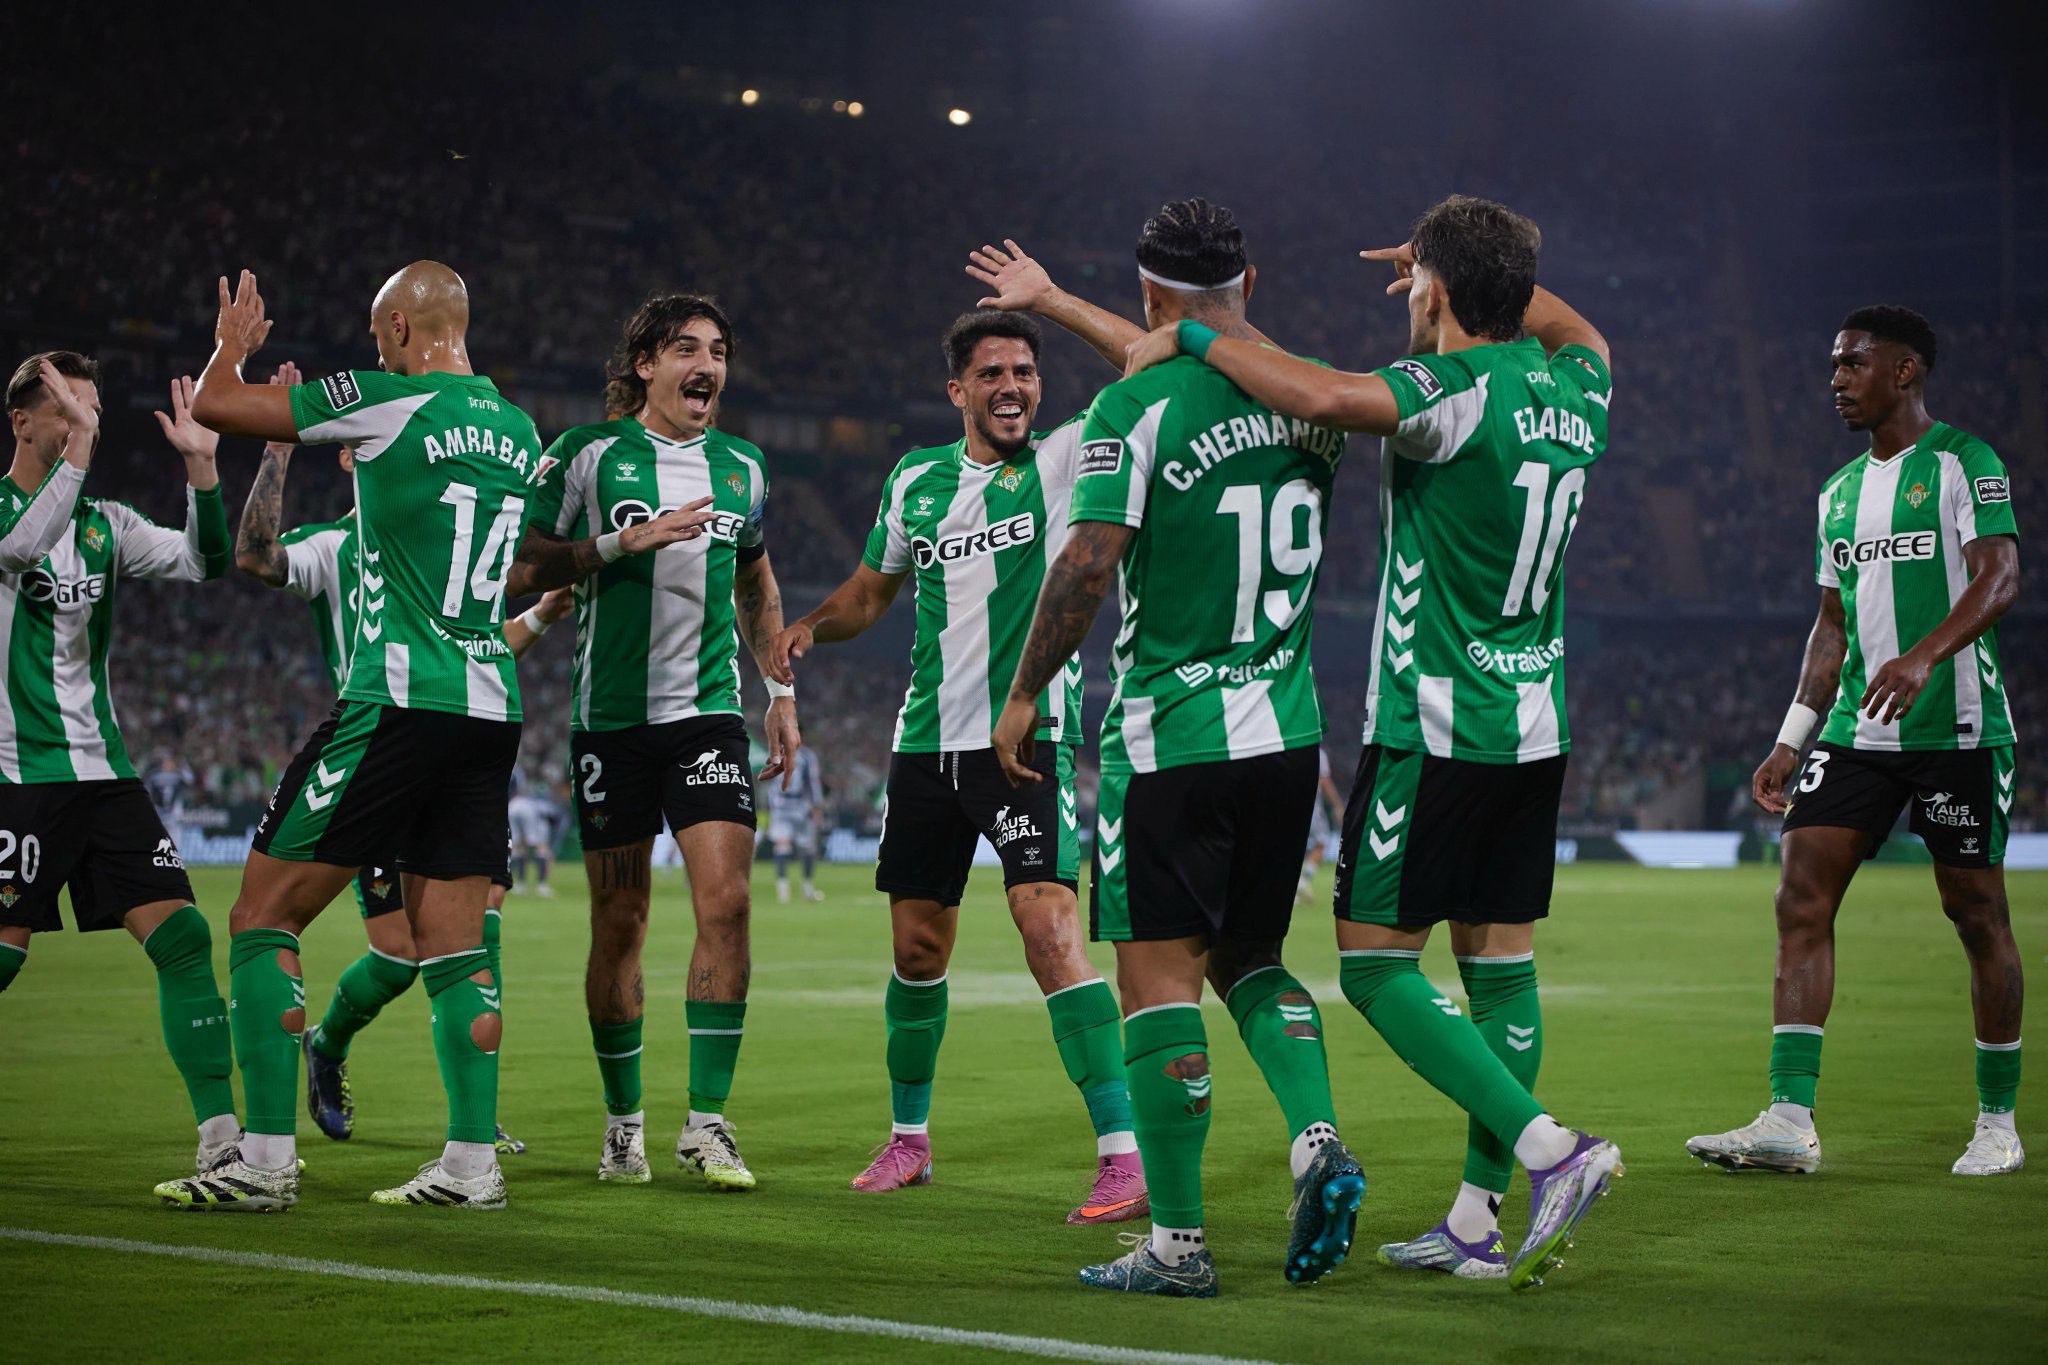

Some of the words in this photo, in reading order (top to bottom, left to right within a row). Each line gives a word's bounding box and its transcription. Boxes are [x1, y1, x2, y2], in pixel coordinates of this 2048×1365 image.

[336, 371, 353, 402] EVEL
[1080, 446, 1117, 461] EVEL
[1979, 481, 2005, 491] REV
[938, 515, 1031, 561] GREE
[1501, 461, 1587, 617] 10
[1854, 534, 1933, 563] GREE
[439, 482, 525, 624] 14
[1215, 478, 1323, 644] 19
[57, 577, 102, 604] GRE
[580, 753, 607, 804] 2
[686, 773, 750, 788] GLOBAL
[706, 763, 740, 775] AUS
[1001, 815, 1030, 833] AUS
[1937, 804, 1970, 816] AUS
[0, 830, 41, 884] 20
